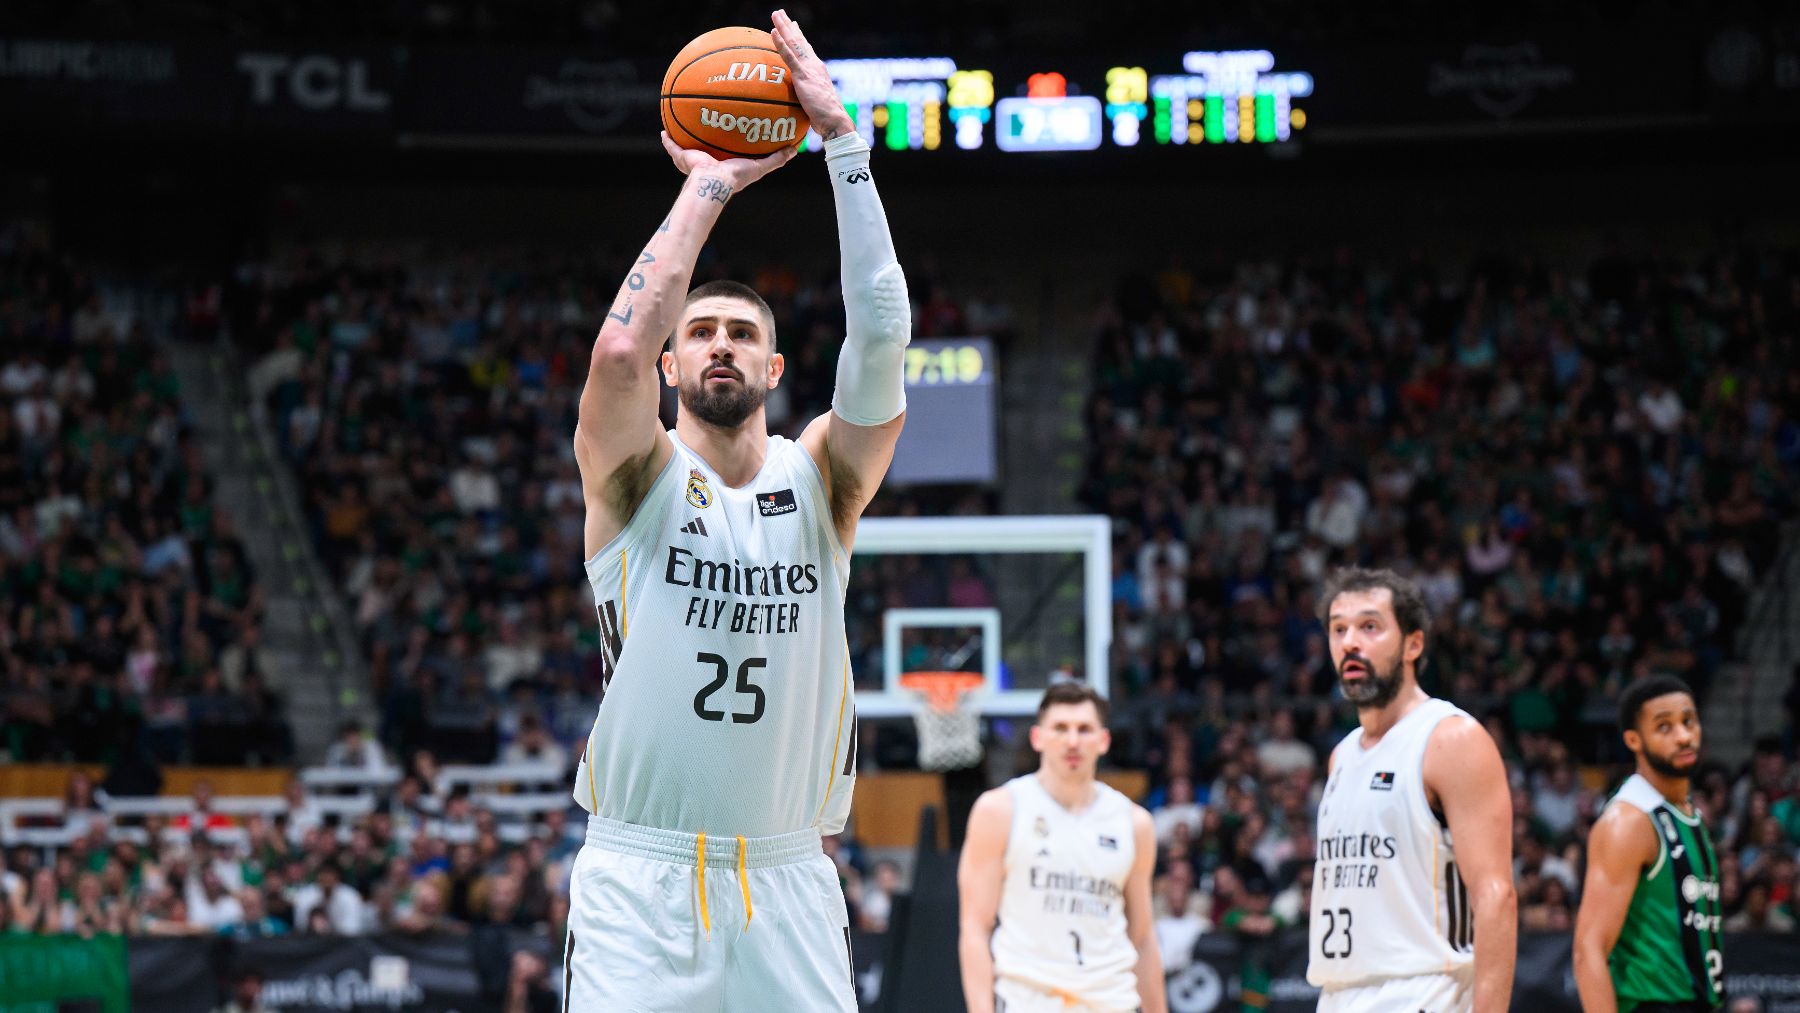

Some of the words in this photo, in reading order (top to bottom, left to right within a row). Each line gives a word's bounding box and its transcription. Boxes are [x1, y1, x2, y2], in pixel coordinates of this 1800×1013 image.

[236, 52, 391, 110] TCL
[700, 107, 797, 143] Wilson
[760, 498, 775, 509] liga
[762, 503, 795, 515] endesa
[665, 545, 818, 597] Emirates
[685, 596, 727, 630] FLY
[693, 652, 767, 724] 25
[1320, 828, 1396, 860] mirates
[1321, 908, 1352, 959] 23
